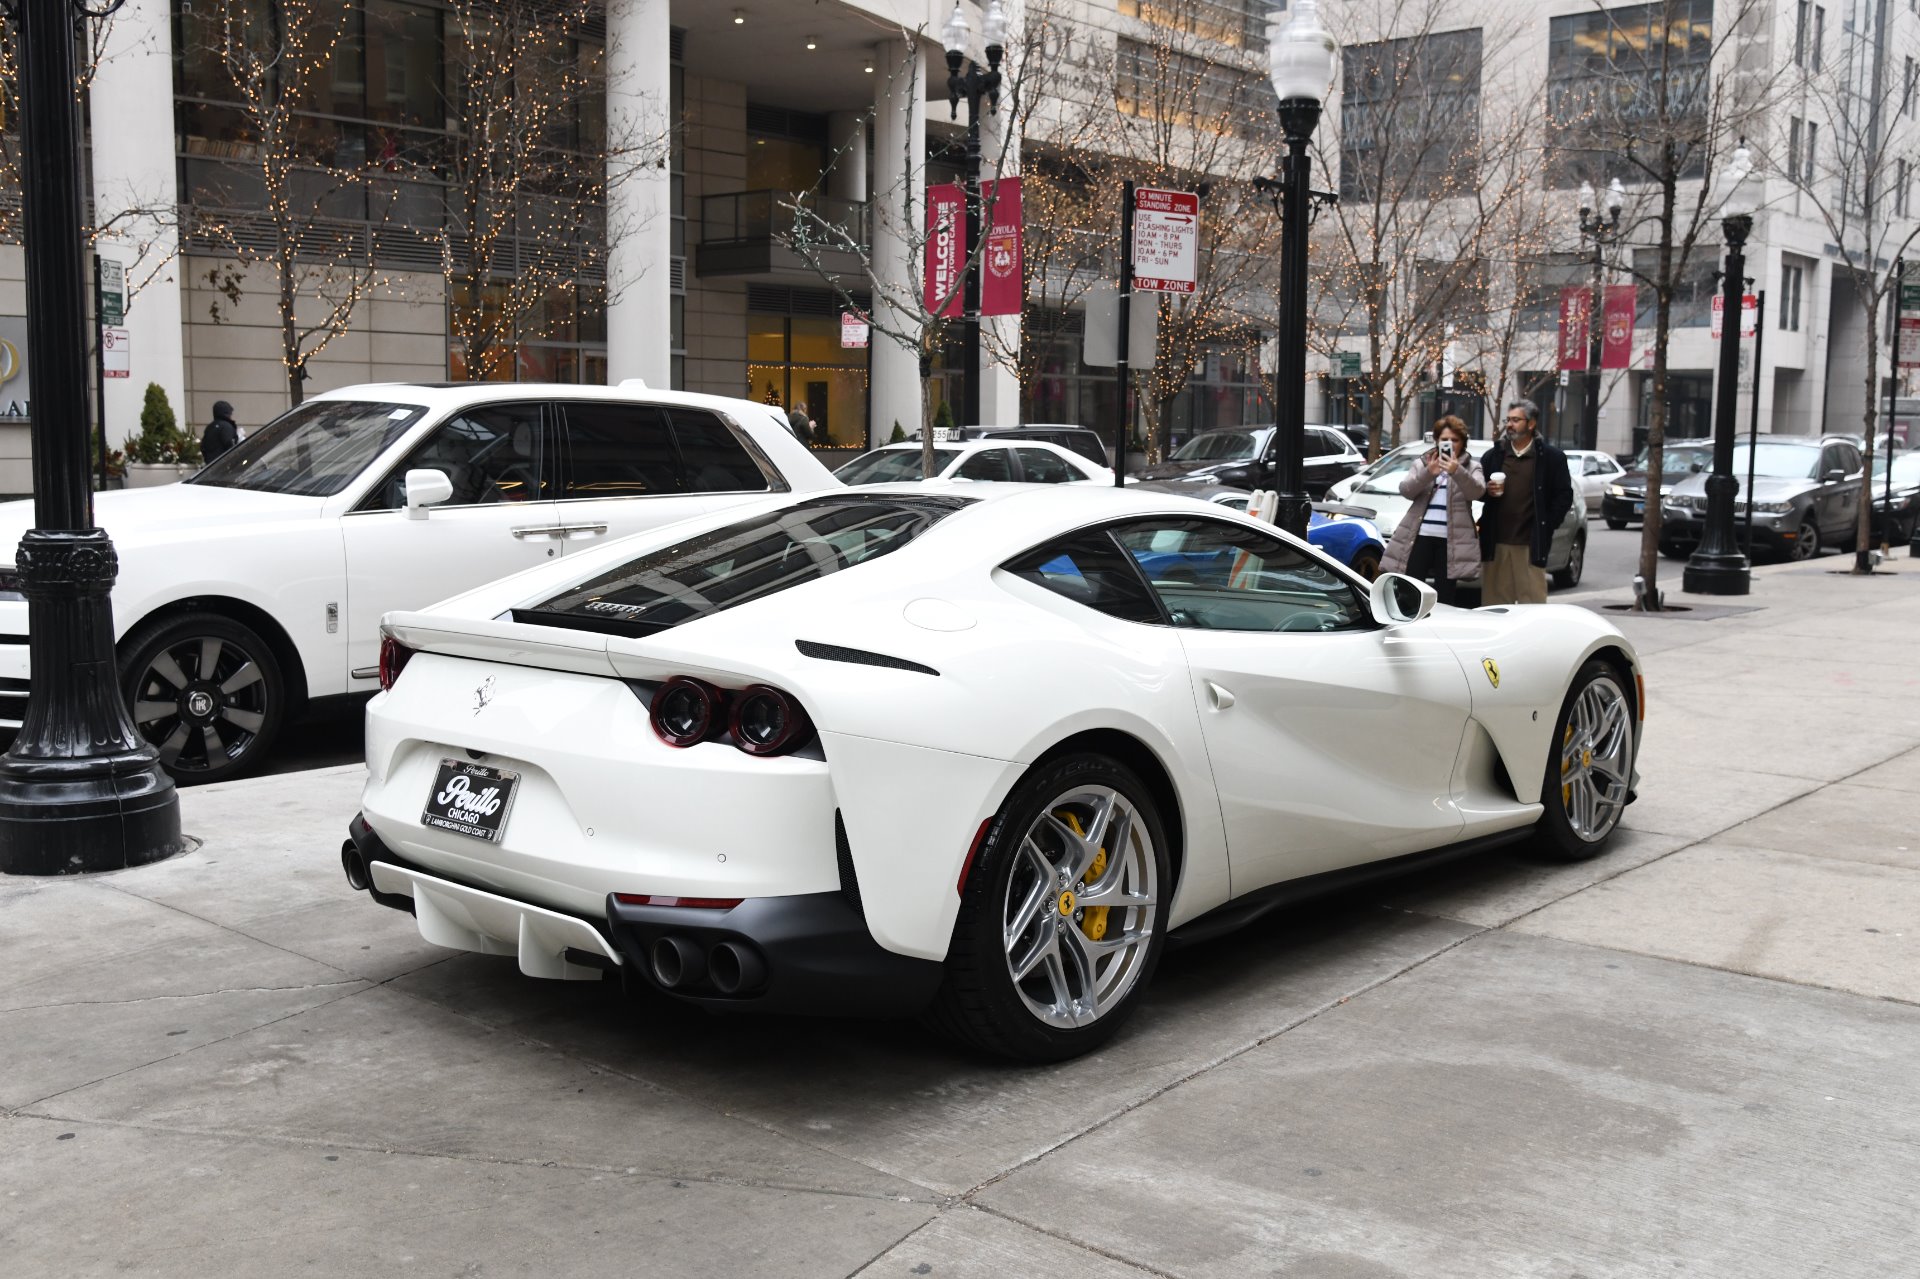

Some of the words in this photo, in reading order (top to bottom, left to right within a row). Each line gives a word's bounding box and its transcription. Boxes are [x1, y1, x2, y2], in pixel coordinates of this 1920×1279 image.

[1034, 20, 1103, 76] OLA
[1139, 191, 1146, 199] 15
[1148, 192, 1172, 202] MINUTE
[1139, 200, 1171, 211] STANDING
[1174, 203, 1191, 213] ZONE
[1138, 214, 1152, 222] USE
[1138, 222, 1170, 232] FLASHING
[1171, 226, 1194, 235] LIGHTS
[1137, 239, 1153, 247] MON
[1160, 241, 1183, 250] THURS
[1137, 247, 1145, 255] 10
[1154, 257, 1169, 265] SUN
[1137, 278, 1158, 289] TOW
[1163, 280, 1190, 291] ZONE
[947, 430, 961, 440] TAXI
[463, 765, 489, 777] Perillo
[437, 775, 501, 816] Perillo
[447, 807, 480, 824] CHICAGO
[431, 817, 460, 830] LAMBORGHINI
[459, 824, 472, 834] GOLD
[471, 827, 487, 837] COAST
